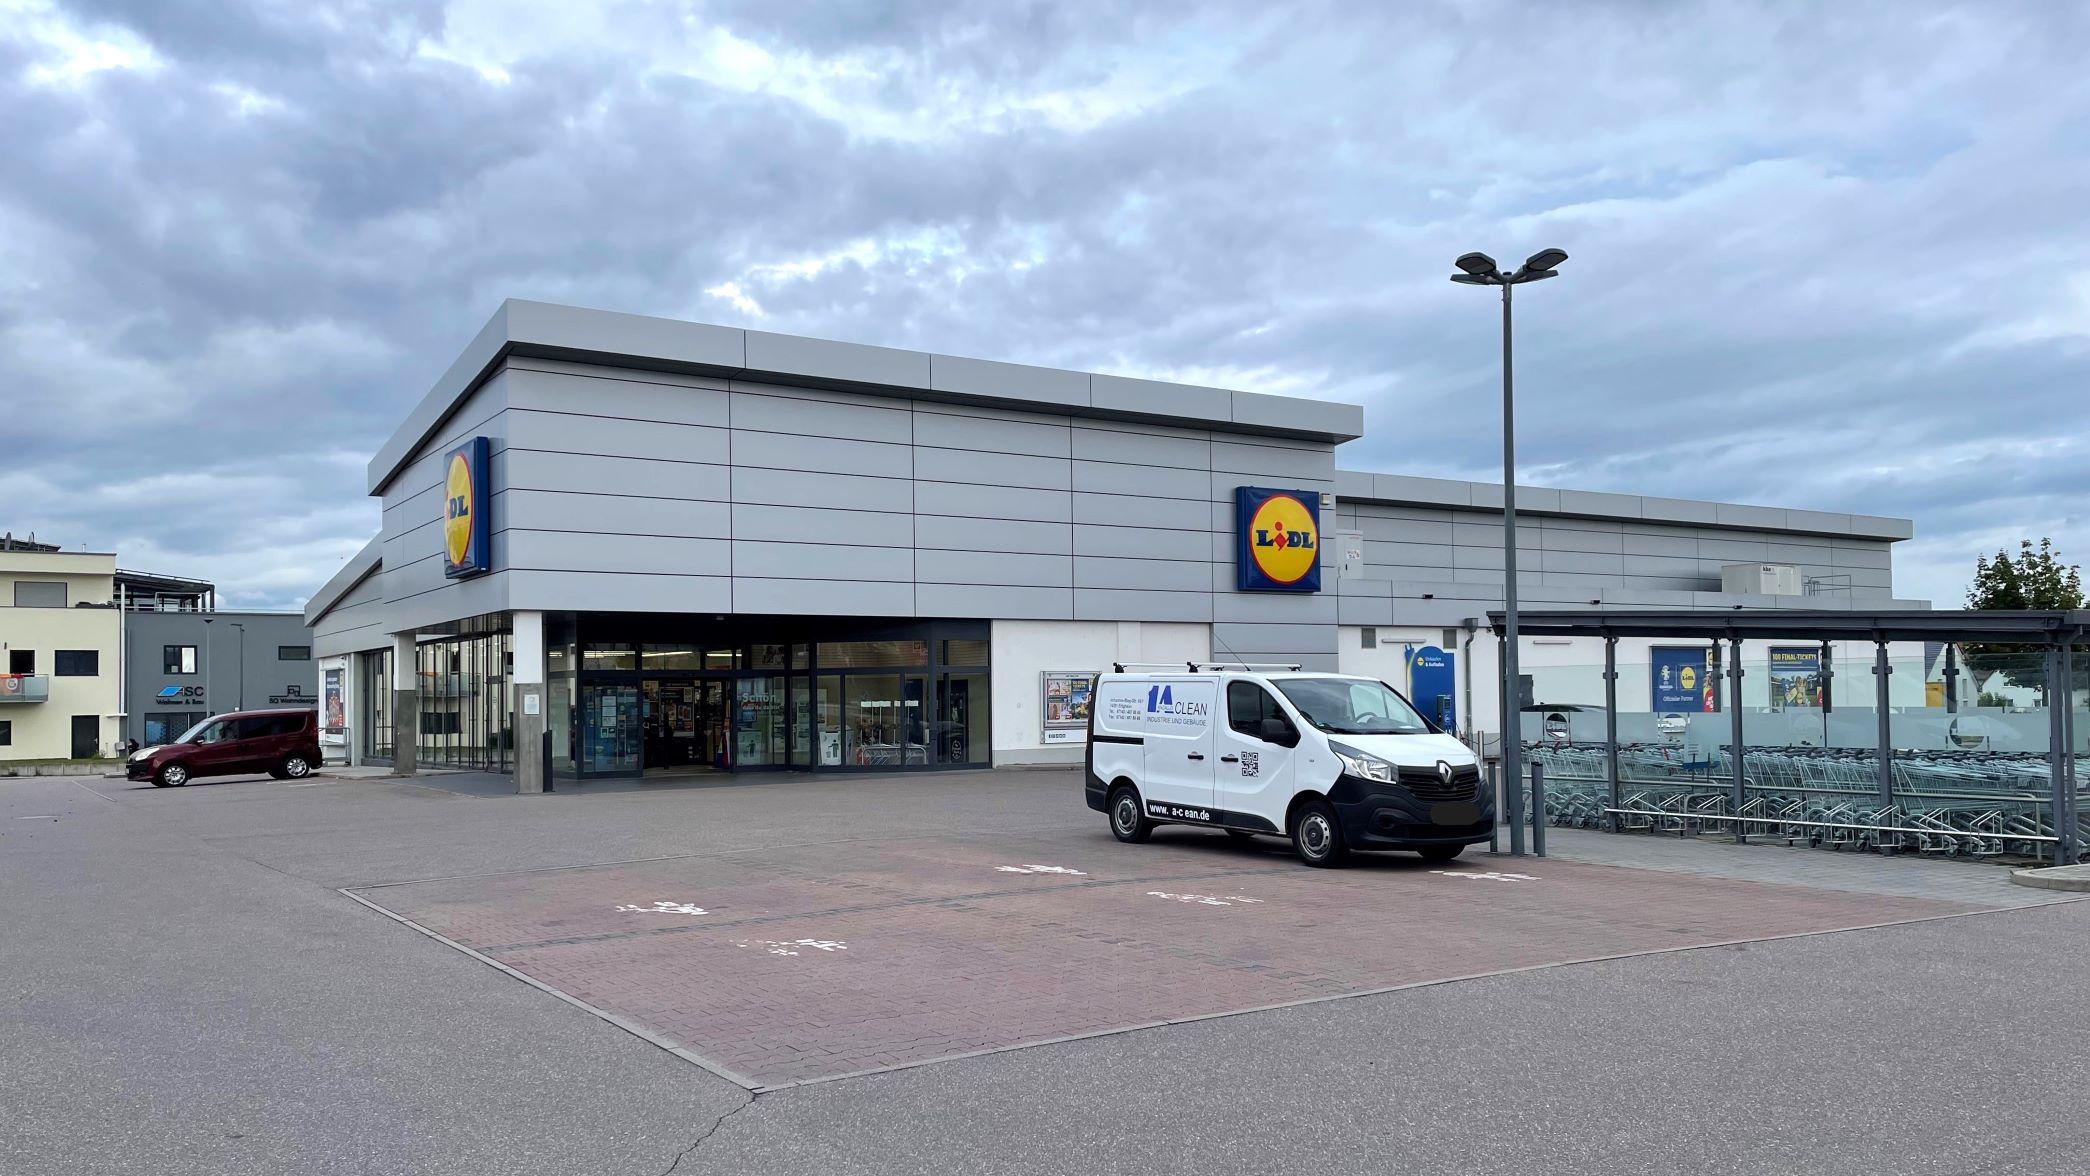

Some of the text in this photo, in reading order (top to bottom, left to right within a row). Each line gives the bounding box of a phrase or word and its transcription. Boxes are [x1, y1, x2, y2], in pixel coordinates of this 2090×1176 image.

[449, 495, 468, 519] DL
[1147, 685, 1208, 716] 1A CLEAN
